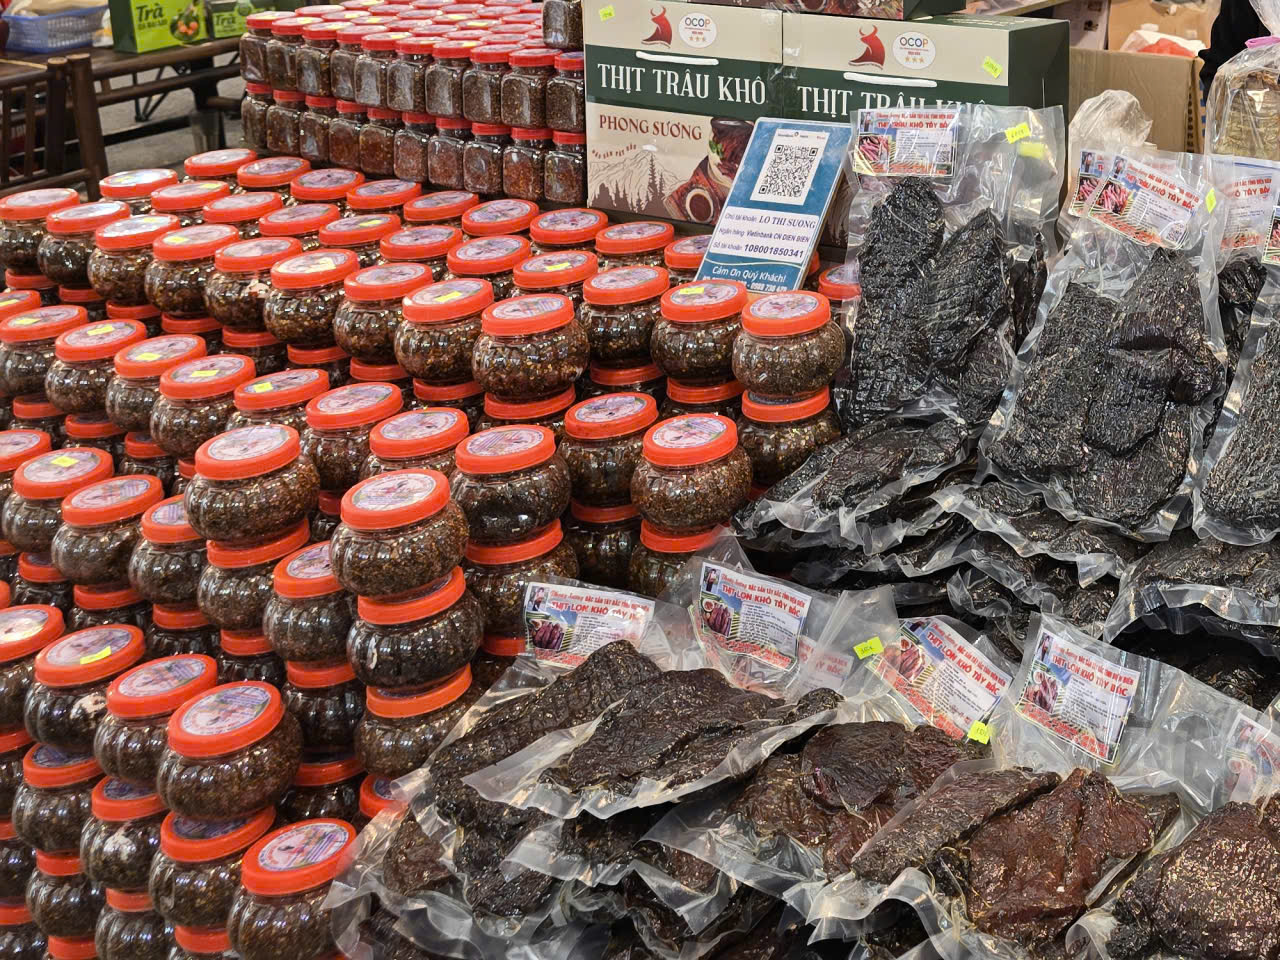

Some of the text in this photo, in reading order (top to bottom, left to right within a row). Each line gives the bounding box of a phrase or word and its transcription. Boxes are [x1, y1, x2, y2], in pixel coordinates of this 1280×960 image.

[136, 4, 164, 22] Trà
[685, 18, 711, 27] OCOP
[900, 37, 929, 48] OCOP
[597, 64, 766, 104] THỊT TRÂU KHÔ
[797, 86, 853, 118] THỊT
[599, 115, 702, 140] PHONG SƯƠNG
[759, 215, 771, 224] LO
[772, 217, 786, 226] THI
[787, 218, 816, 229] SUONG
[744, 244, 804, 258] 108001850341
[712, 266, 729, 275] Cảm
[742, 270, 759, 281] Quý
[722, 584, 736, 598] THỊT
[755, 594, 772, 604] KHÔ
[774, 599, 788, 610] TÂY
[789, 605, 801, 617] BẮC
[591, 606, 608, 615] KHÔ
[927, 632, 943, 649] THỊT
[957, 657, 972, 673] KHÔ
[971, 669, 987, 685] TÂY
[985, 682, 1001, 696] BẮC
[1052, 655, 1066, 668] THỊT
[1080, 668, 1095, 682] KHÔ
